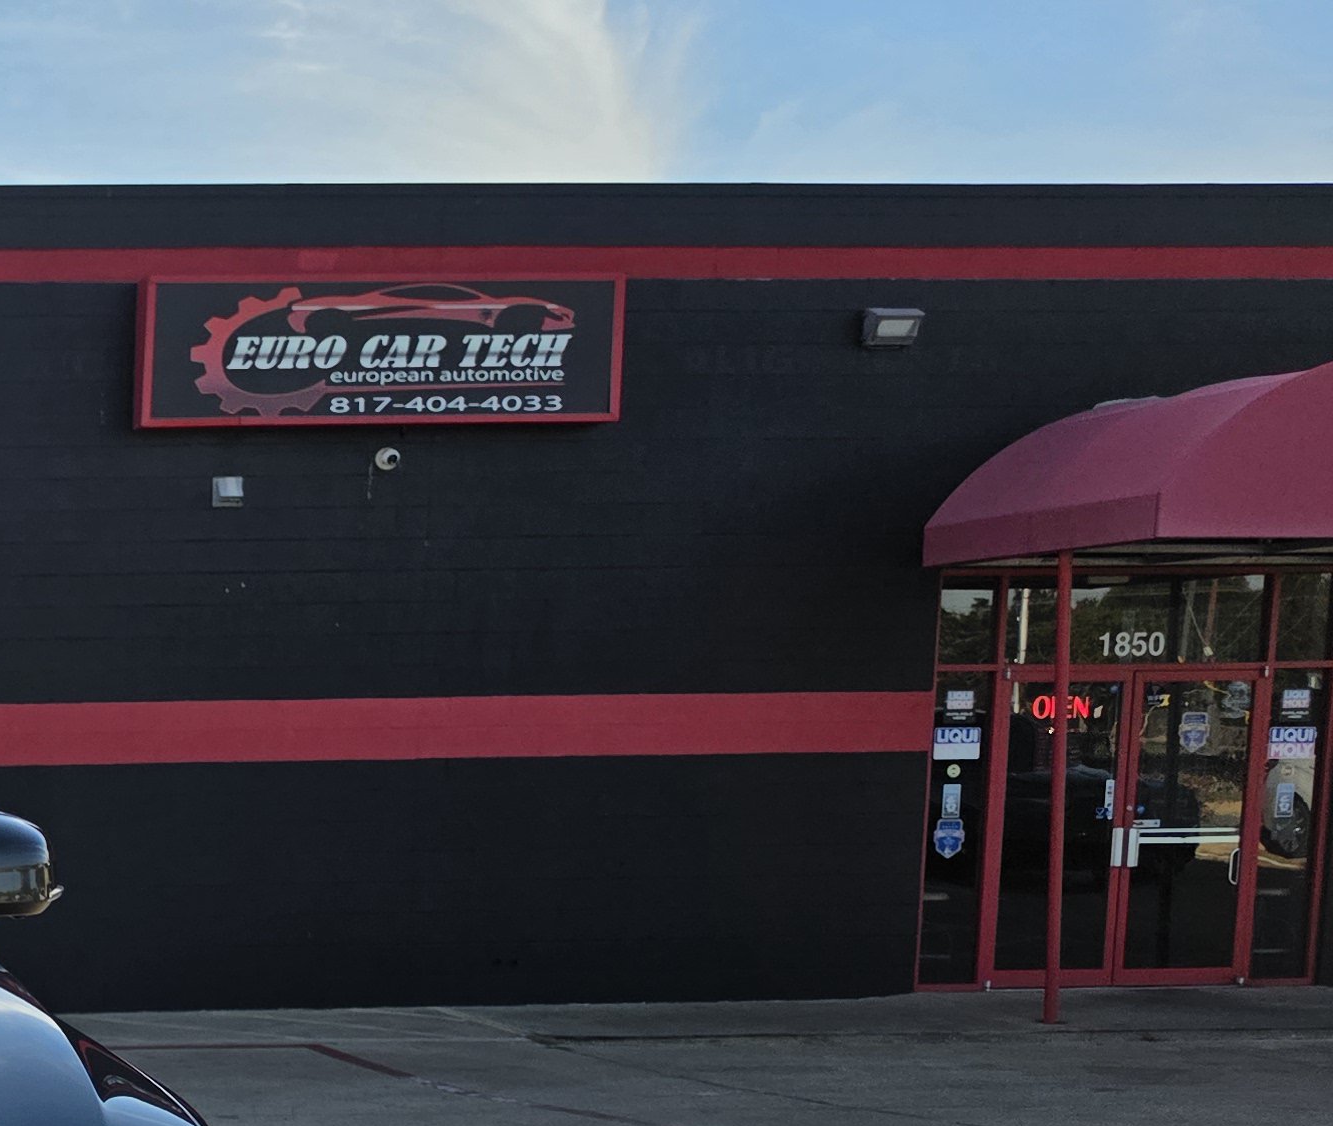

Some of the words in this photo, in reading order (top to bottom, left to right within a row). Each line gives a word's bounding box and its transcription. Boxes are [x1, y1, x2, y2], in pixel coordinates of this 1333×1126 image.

[226, 335, 347, 370] EURO
[359, 334, 447, 368] CAR
[458, 333, 572, 367] TECH
[330, 370, 434, 386] european
[439, 366, 565, 383] automotive
[329, 395, 563, 414] 817-404-4033
[1099, 631, 1165, 657] 1850
[936, 728, 979, 743] LIQUI
[1271, 728, 1314, 742] LIQUI
